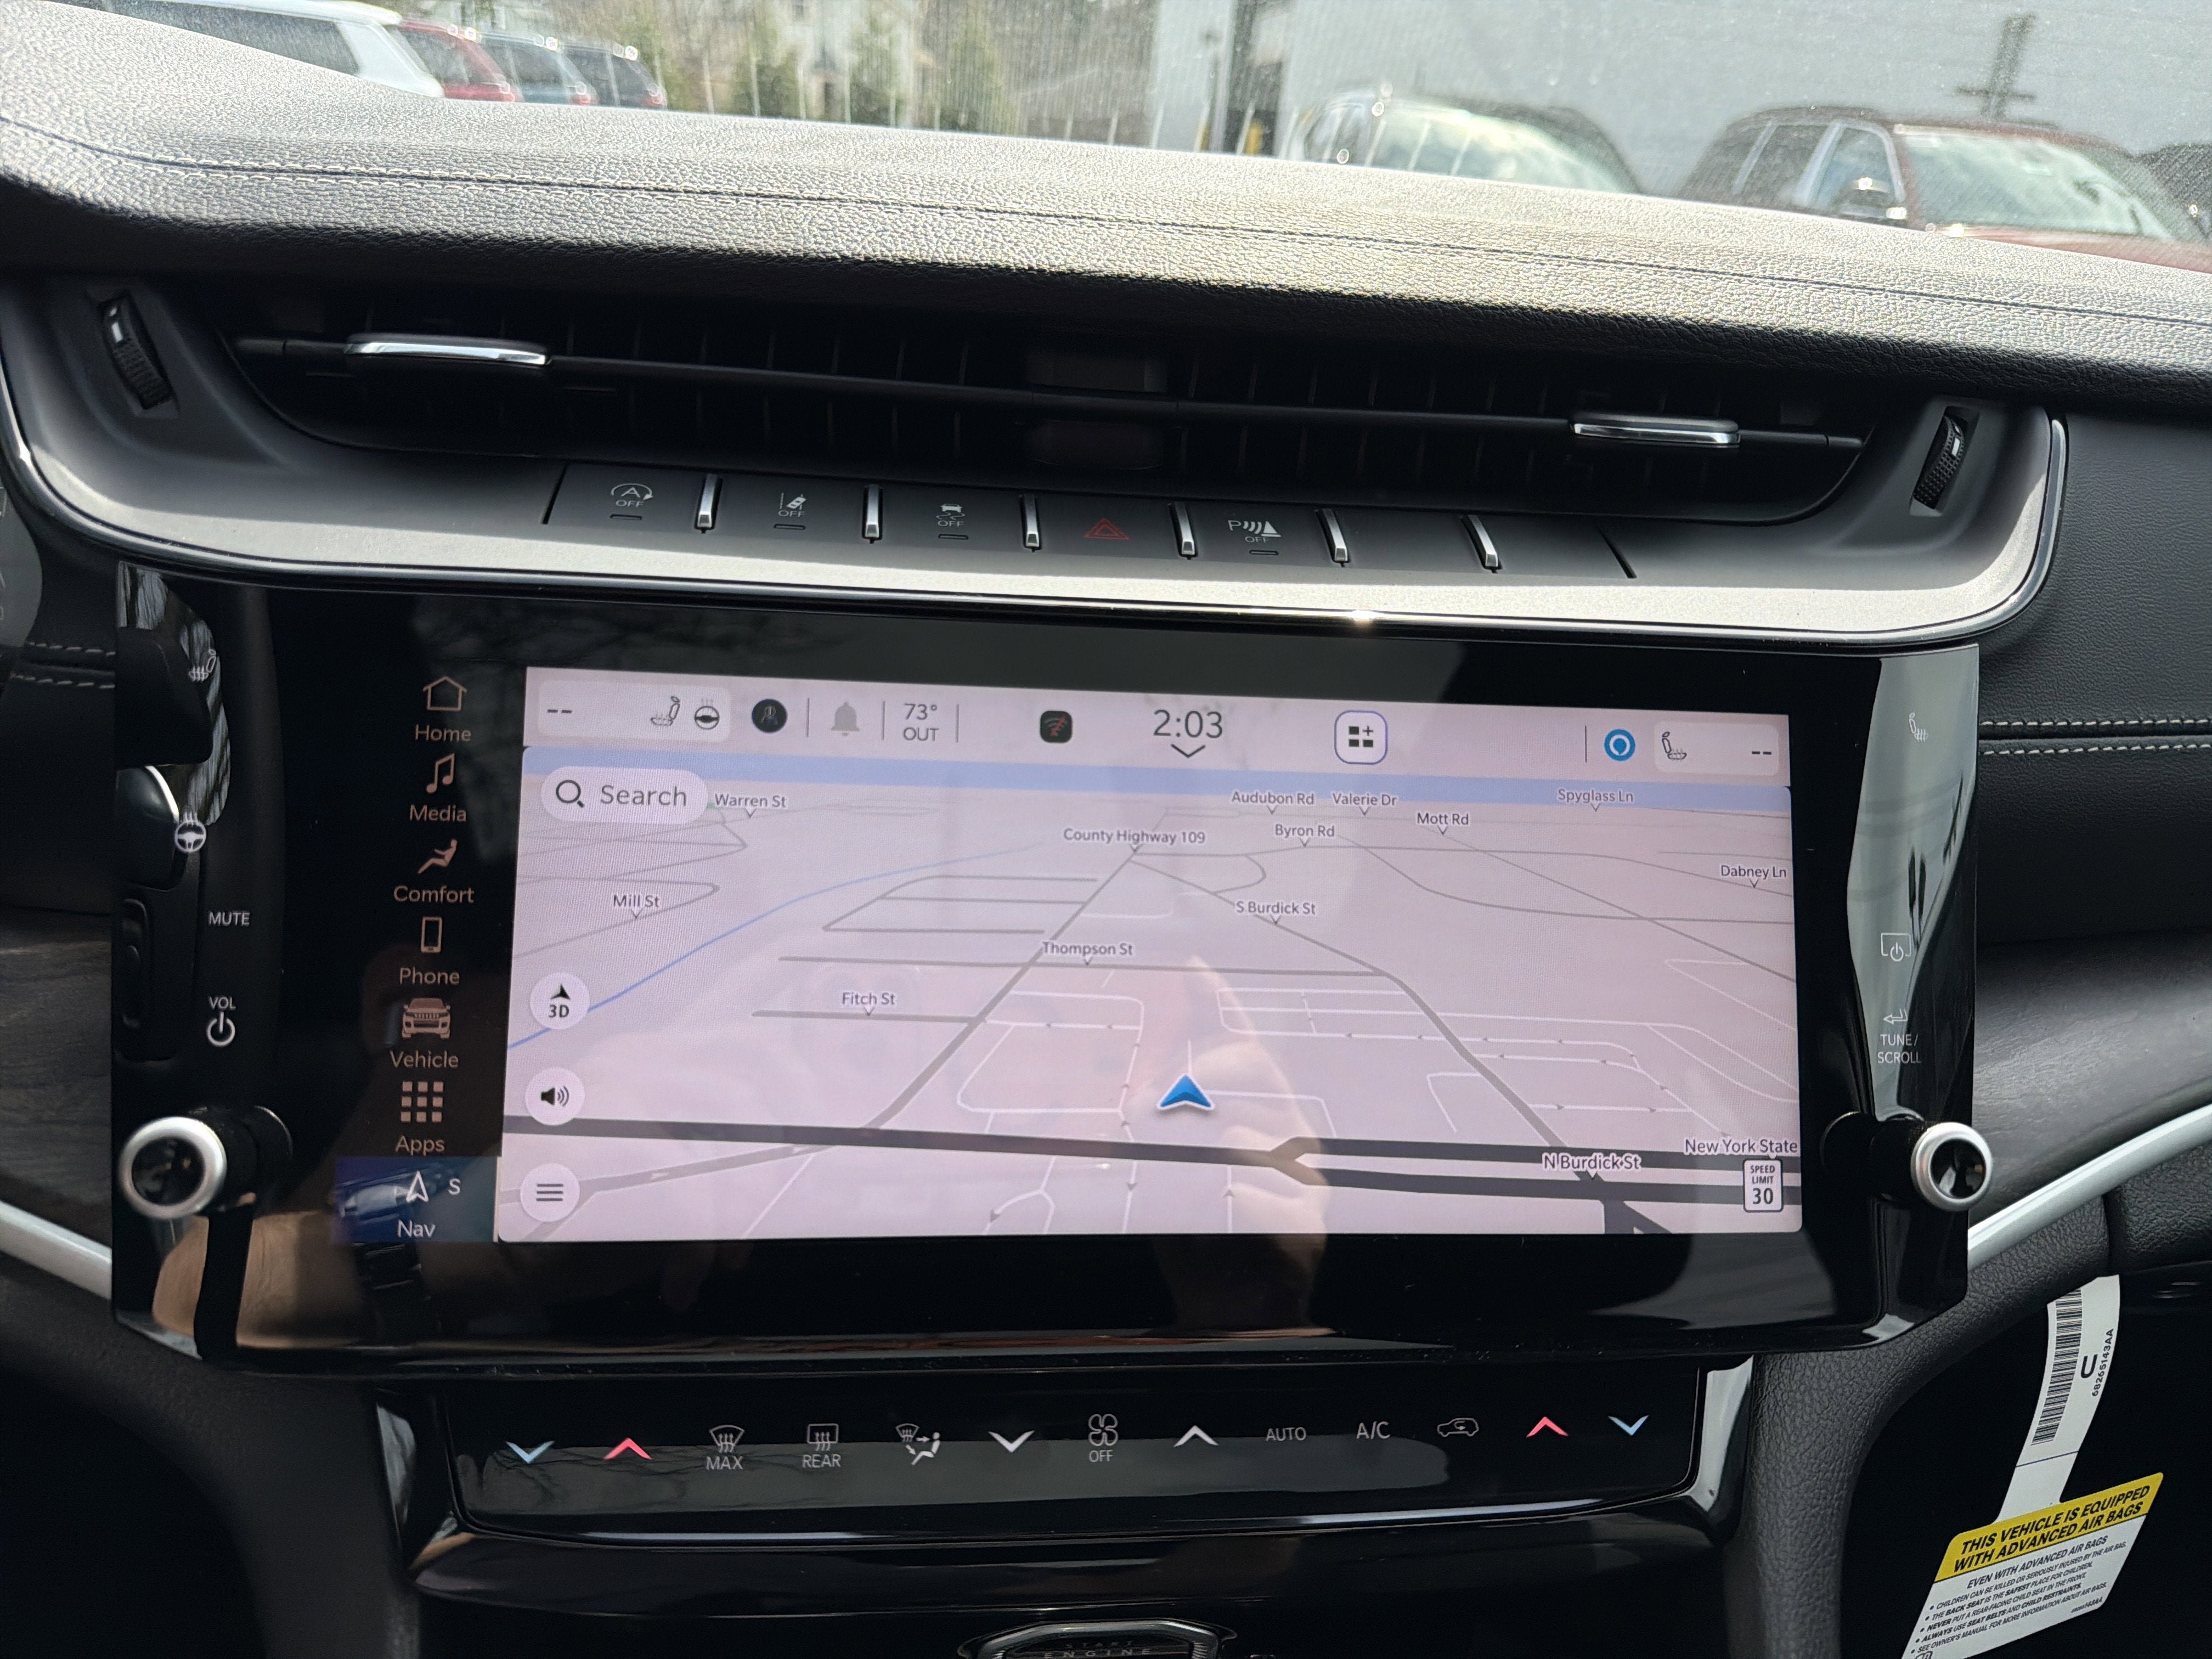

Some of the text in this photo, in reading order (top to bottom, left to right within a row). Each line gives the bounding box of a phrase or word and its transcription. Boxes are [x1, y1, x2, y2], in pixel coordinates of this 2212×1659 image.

[615, 499, 645, 507] OFF
[777, 509, 806, 518] OFF
[1244, 535, 1269, 544] OFF
[1153, 709, 1223, 739] 2:03
[415, 724, 471, 742] Home
[902, 727, 939, 742] OUT
[600, 785, 687, 806] Search
[715, 793, 787, 808] Warren St
[1232, 792, 1314, 805] Audubon Rd
[1332, 793, 1397, 806] Valerie Dr
[1558, 789, 1634, 804] Spyglass Ln
[409, 804, 466, 822] Media
[1417, 812, 1469, 826] Mott Rd
[1063, 828, 1205, 845] County Highway 109
[1275, 823, 1335, 838] Byron Rd
[1720, 865, 1787, 880] Dabney Ln
[393, 885, 475, 904] Comfort
[613, 894, 659, 908] Mill St
[1236, 901, 1316, 915] S Burdick St
[208, 911, 251, 927] MUTE
[1042, 941, 1133, 957] Thompson St
[399, 967, 460, 985] Phone
[208, 996, 237, 1010] VOL
[842, 992, 895, 1006] Fitch St
[548, 1005, 569, 1018] 3D
[1880, 1034, 1918, 1046] TUNE/
[390, 1051, 459, 1069] Vehicle
[1877, 1052, 1921, 1064] SCROLL
[395, 1135, 445, 1156] Apps
[1685, 1139, 1798, 1153] New York State
[1543, 1156, 1640, 1170] N Burdick St
[1750, 1165, 1775, 1174] SPEED
[449, 1178, 461, 1195] S
[1752, 1176, 1774, 1184] LIMIT
[1752, 1188, 1774, 1205] 30
[397, 1220, 436, 1238] Nav
[1266, 1427, 1307, 1442] AUTO
[1357, 1421, 1391, 1440] A/C
[706, 1455, 743, 1470] MAX
[802, 1454, 842, 1468] REAR
[1089, 1450, 1114, 1463] OFF
[1961, 1485, 2150, 1555] THIS VEHICLE IS EQUIPPED
[1954, 1501, 2143, 1572] WITH ADVANCED AIR BAGS
[1967, 1535, 2108, 1589] EVEN WITH ADVANCED AIR BAGS
[1937, 1593, 1970, 1609] CHILDREN
[1970, 1589, 1984, 1599] CAN
[1984, 1585, 1994, 1594] BE
[1994, 1579, 2015, 1591] KILLED
[2025, 1564, 2059, 1580] SERIOUSLY
[2083, 1553, 2092, 1561] BY
[2092, 1548, 2104, 1558] THE
[1932, 1611, 1945, 1621] THE
[1945, 1604, 1966, 1616] BACK
[1966, 1598, 1985, 1609] SEAT
[1992, 1592, 2005, 1601] THE
[2005, 1582, 2031, 1596] SAFEST
[2030, 1576, 2050, 1588] PLACE
[2050, 1571, 2063, 1581] FOR
[1927, 1618, 1952, 1632] NEVER
[1951, 1613, 1966, 1623] PUT
[2012, 1592, 2031, 1603] CHILD
[2032, 1585, 2048, 1596] SEAT
[2055, 1579, 2067, 1588] THE
[1921, 1627, 1953, 1643] ALWAYS
[1953, 1622, 1967, 1632] USE
[1967, 1616, 1985, 1628] SEAT
[1985, 1609, 2007, 1621] BELTS
[2006, 1604, 2021, 1614] AND
[2021, 1597, 2042, 1609] CHILD
[1917, 1643, 1931, 1653] SEE
[1961, 1624, 1988, 1639] MANUAL
[1989, 1619, 2002, 1629] FOR
[2002, 1612, 2022, 1624] MORE
[1045, 1648, 1150, 1658] ENGINE
